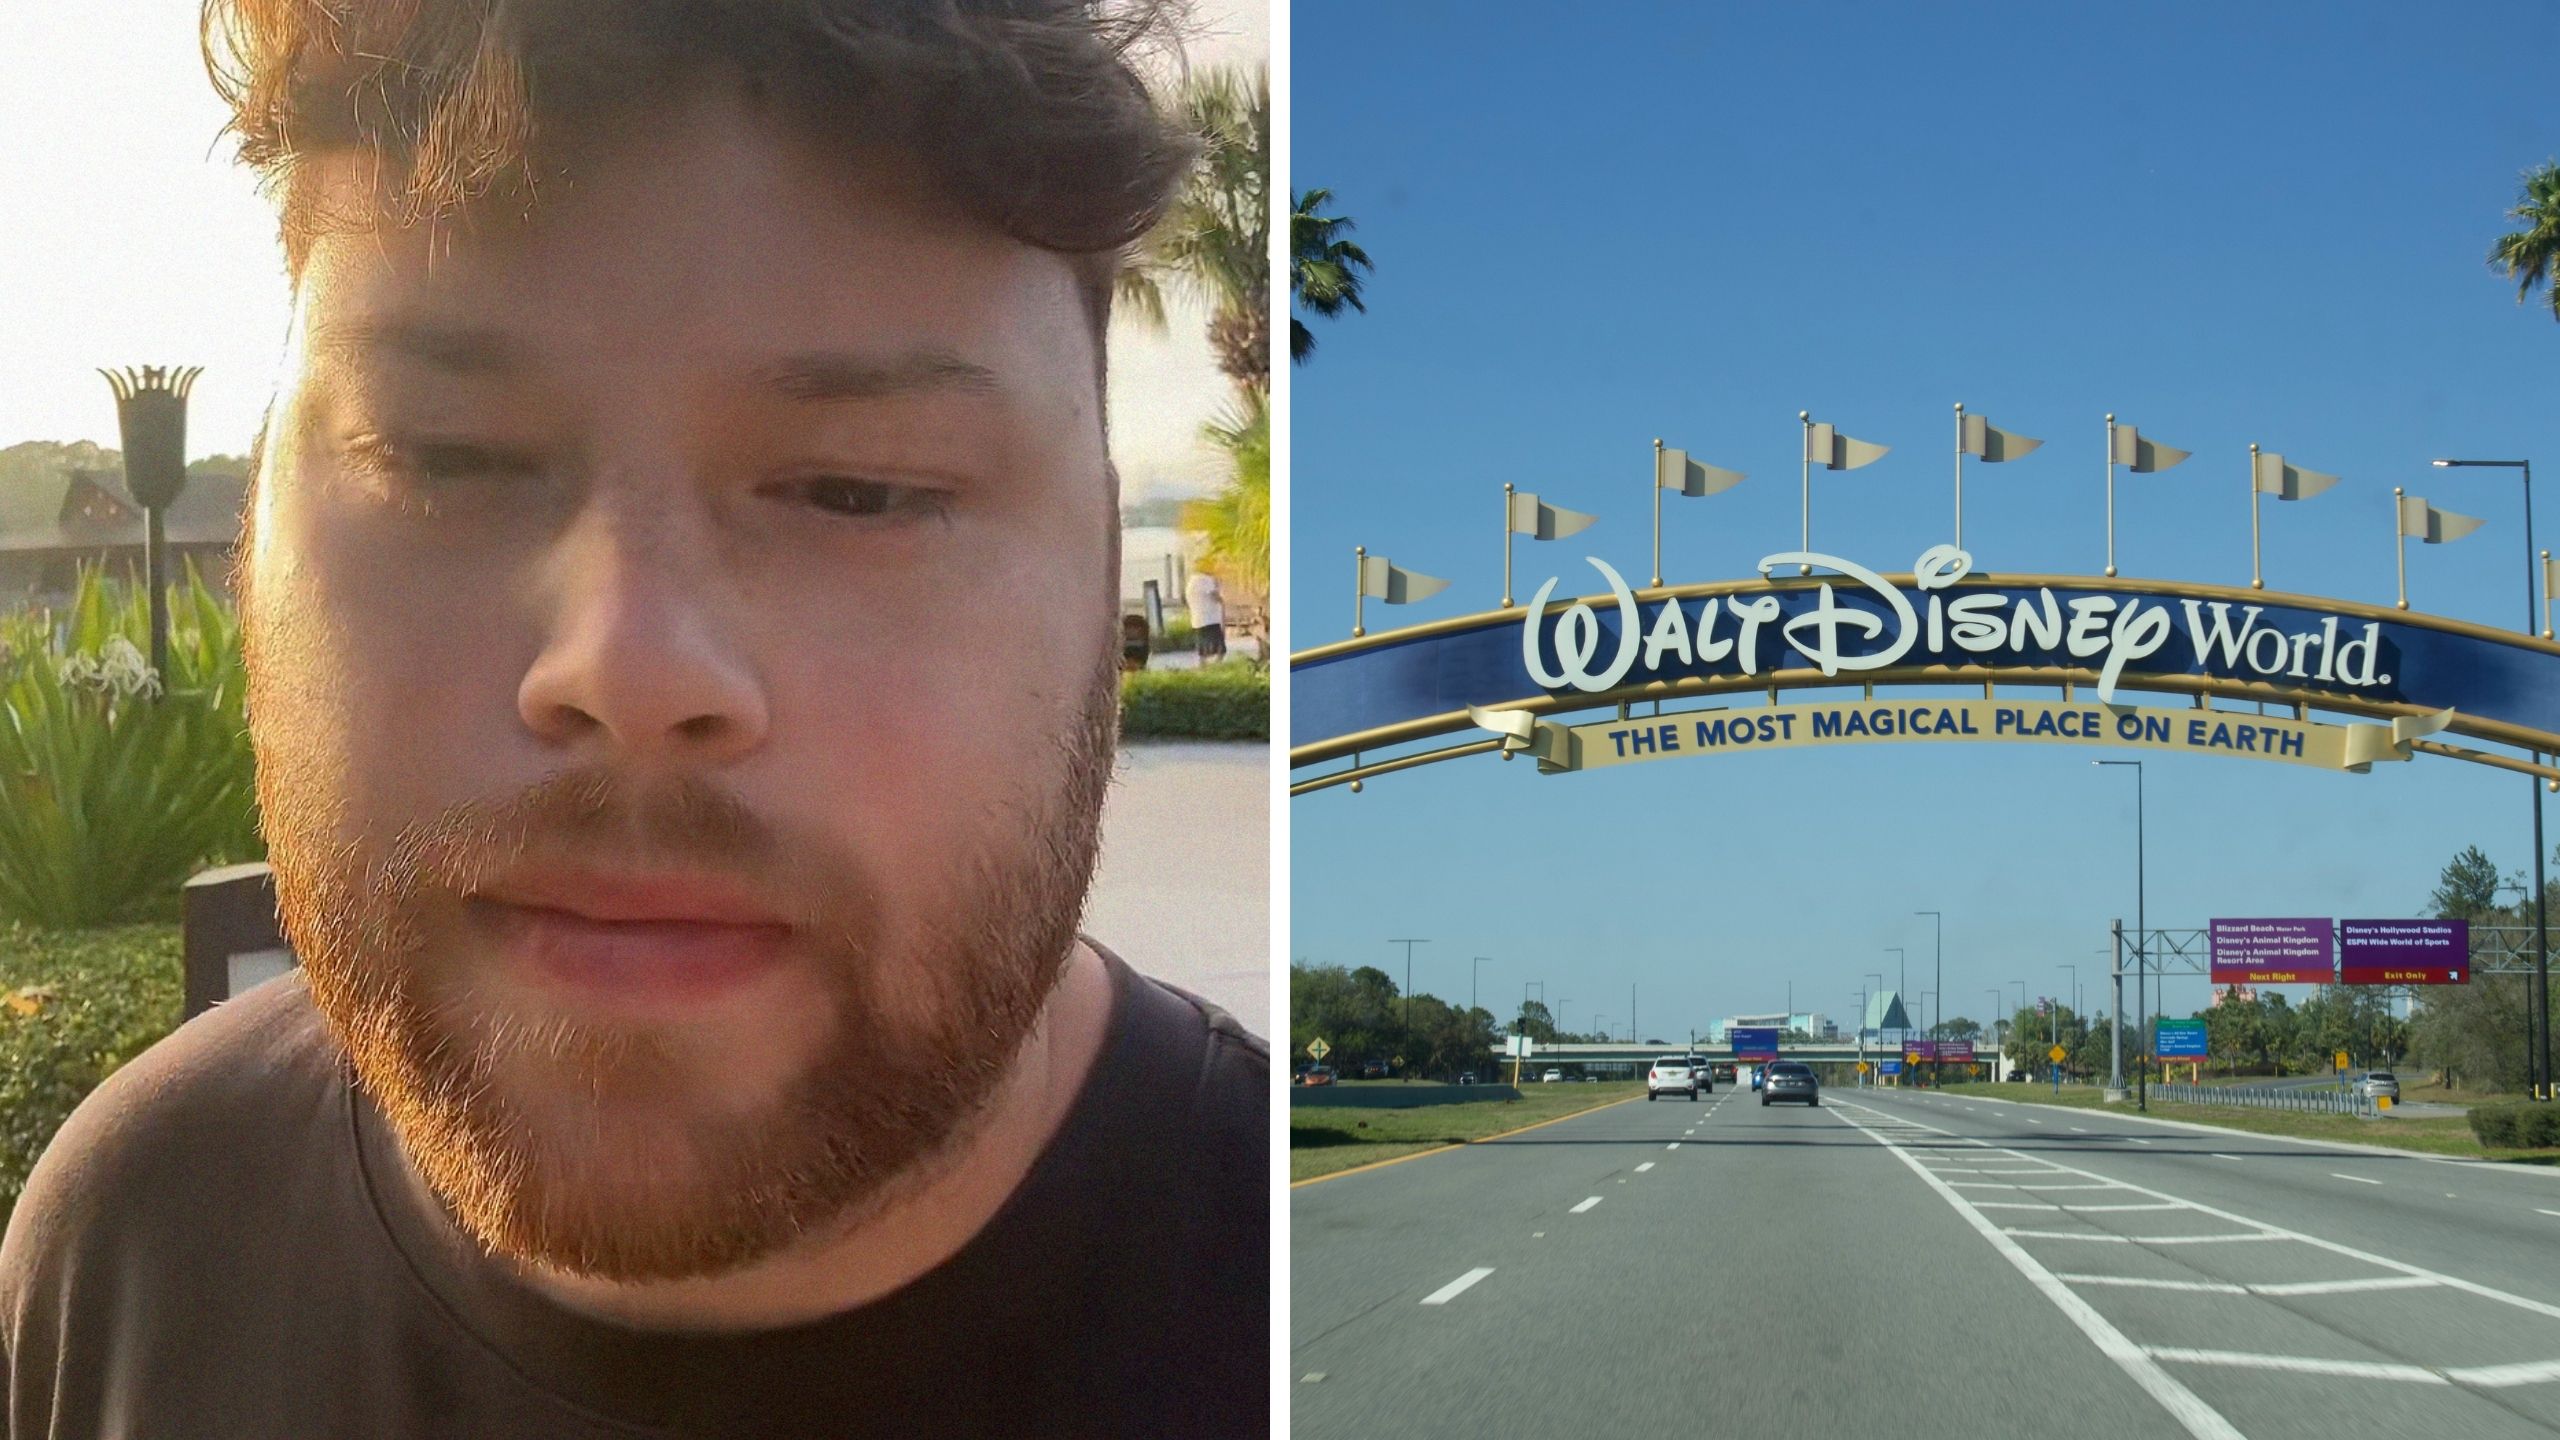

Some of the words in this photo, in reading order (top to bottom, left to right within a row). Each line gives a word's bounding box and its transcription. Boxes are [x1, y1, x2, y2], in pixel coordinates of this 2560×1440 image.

[1609, 724, 1681, 758] THE
[1698, 713, 1797, 748] MOST
[1812, 707, 1978, 738] MAGICAL
[1995, 708, 2101, 739] PLACE
[2116, 714, 2171, 743] ON
[2188, 720, 2305, 758] EARTH
[2216, 924, 2248, 933] Blizzard
[2250, 924, 2275, 933] Beach
[2346, 926, 2379, 935] Disney's
[2380, 926, 2421, 935] Hollywood
[2422, 926, 2452, 934] Studios
[2216, 936, 2251, 946] Disney's
[2252, 936, 2281, 944] Animal
[2283, 936, 2319, 946] Kingdom
[2346, 938, 2368, 946] ESPN
[2369, 938, 2389, 946] Wide
[2390, 938, 2413, 946] World
[2414, 938, 2423, 946] of
[2424, 938, 2450, 947] Sports
[2216, 948, 2251, 957] Disney's
[2252, 948, 2281, 956] Animal
[2283, 948, 2319, 957] Kingdom
[2249, 973, 2270, 981] Next
[2272, 972, 2296, 982] Right
[2384, 972, 2402, 980] Exit
[2405, 972, 2427, 981] Only
